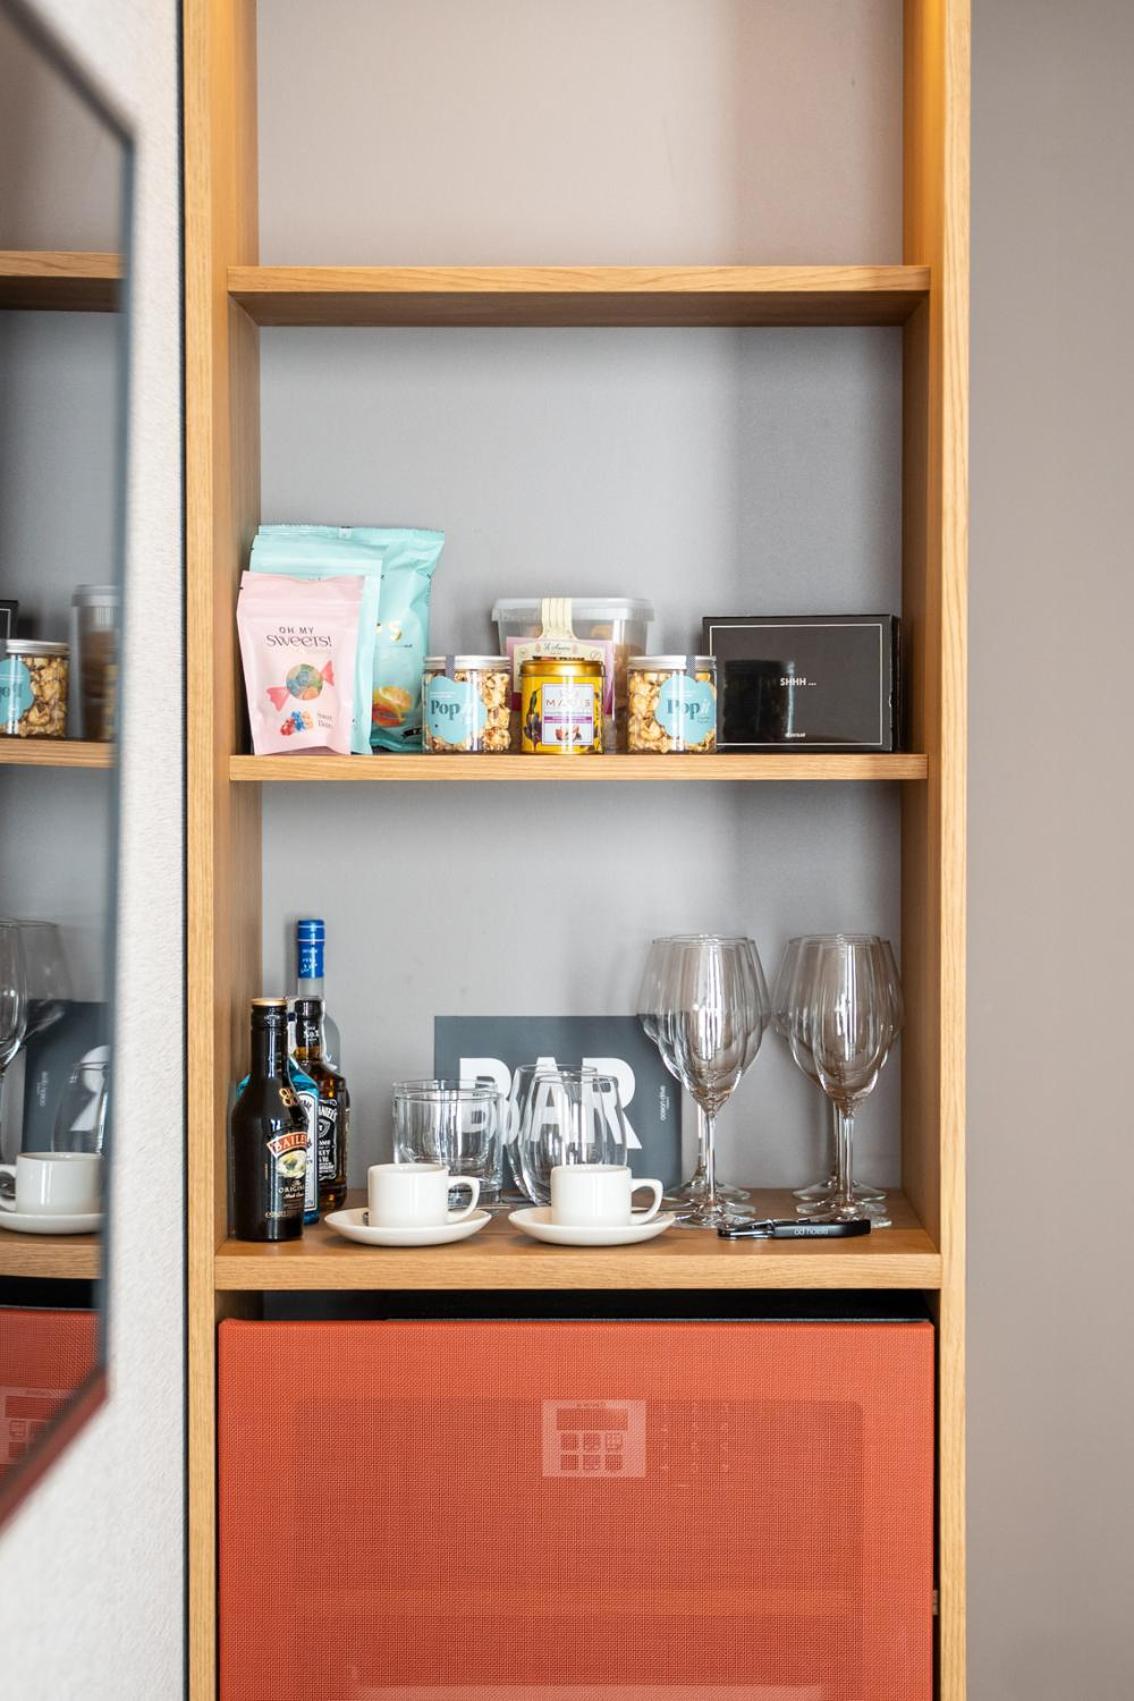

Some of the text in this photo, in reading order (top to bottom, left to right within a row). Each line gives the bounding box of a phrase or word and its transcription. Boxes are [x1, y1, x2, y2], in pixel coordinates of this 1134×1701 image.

[279, 626, 314, 635] OH MY
[431, 700, 461, 720] Pop
[459, 1056, 643, 1149] BAR
[274, 1134, 308, 1151] BAILE
